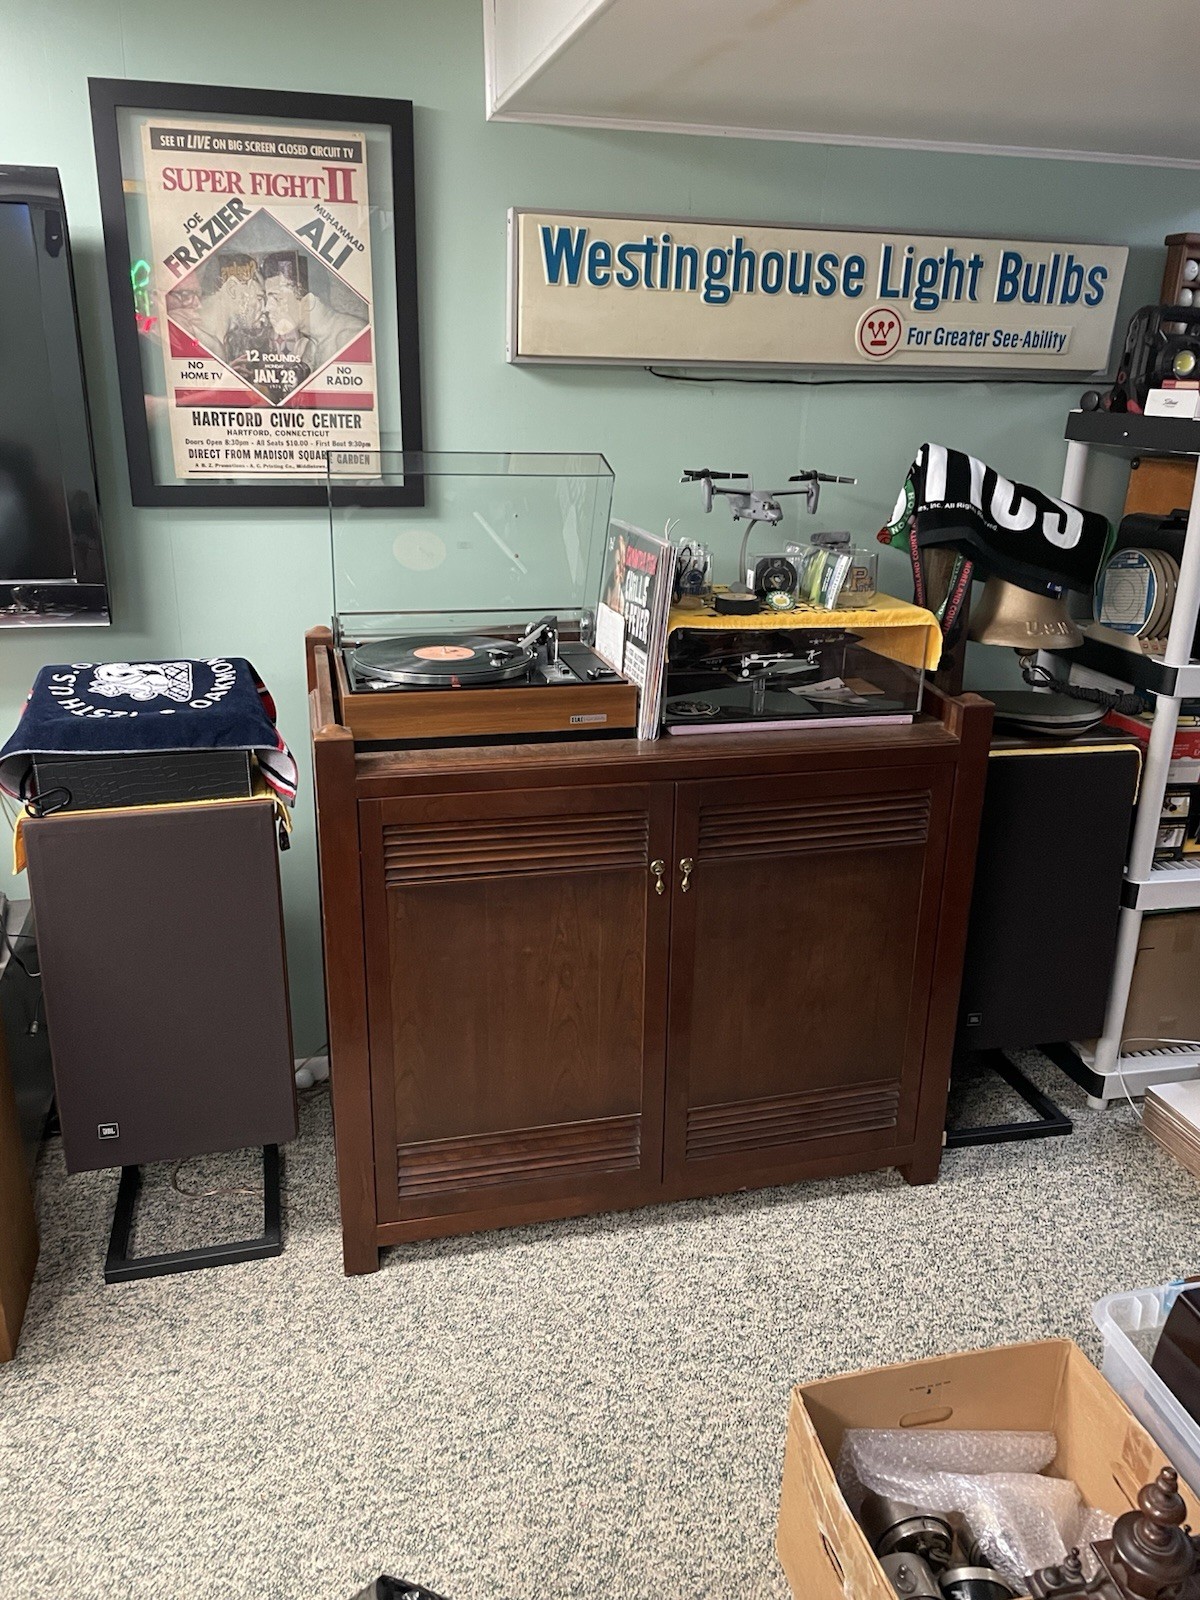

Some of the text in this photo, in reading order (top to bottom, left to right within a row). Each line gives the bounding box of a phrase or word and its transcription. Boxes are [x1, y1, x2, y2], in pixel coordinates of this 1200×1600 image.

[160, 134, 354, 159] SEE IT LIVE ON BIG SCREEN CLOSED CIRCUIT TV
[162, 166, 358, 204] SUPER FIGHT II
[183, 212, 204, 234] JOE
[314, 203, 365, 252] MUHAMMAD
[163, 196, 252, 279] FRAZIER
[295, 217, 354, 270] ALI
[539, 226, 1108, 312] Westinghouse Light Bulbs
[907, 327, 1067, 352] For Greater See-Ability
[245, 350, 301, 363] 12 ROUNDS
[181, 371, 223, 380] HOME TV
[253, 369, 296, 384] JAN. 28
[326, 375, 363, 386] RADIO
[336, 366, 352, 374] NO
[192, 411, 362, 429] HARTFORD CIVIC CENTER
[227, 429, 272, 437] HARTFORD,
[188, 449, 220, 459] DIRECT
[225, 449, 251, 459] FROM
[254, 450, 294, 460] MADISON
[337, 454, 370, 465] GARDEN
[189, 658, 236, 709] OAKMON
